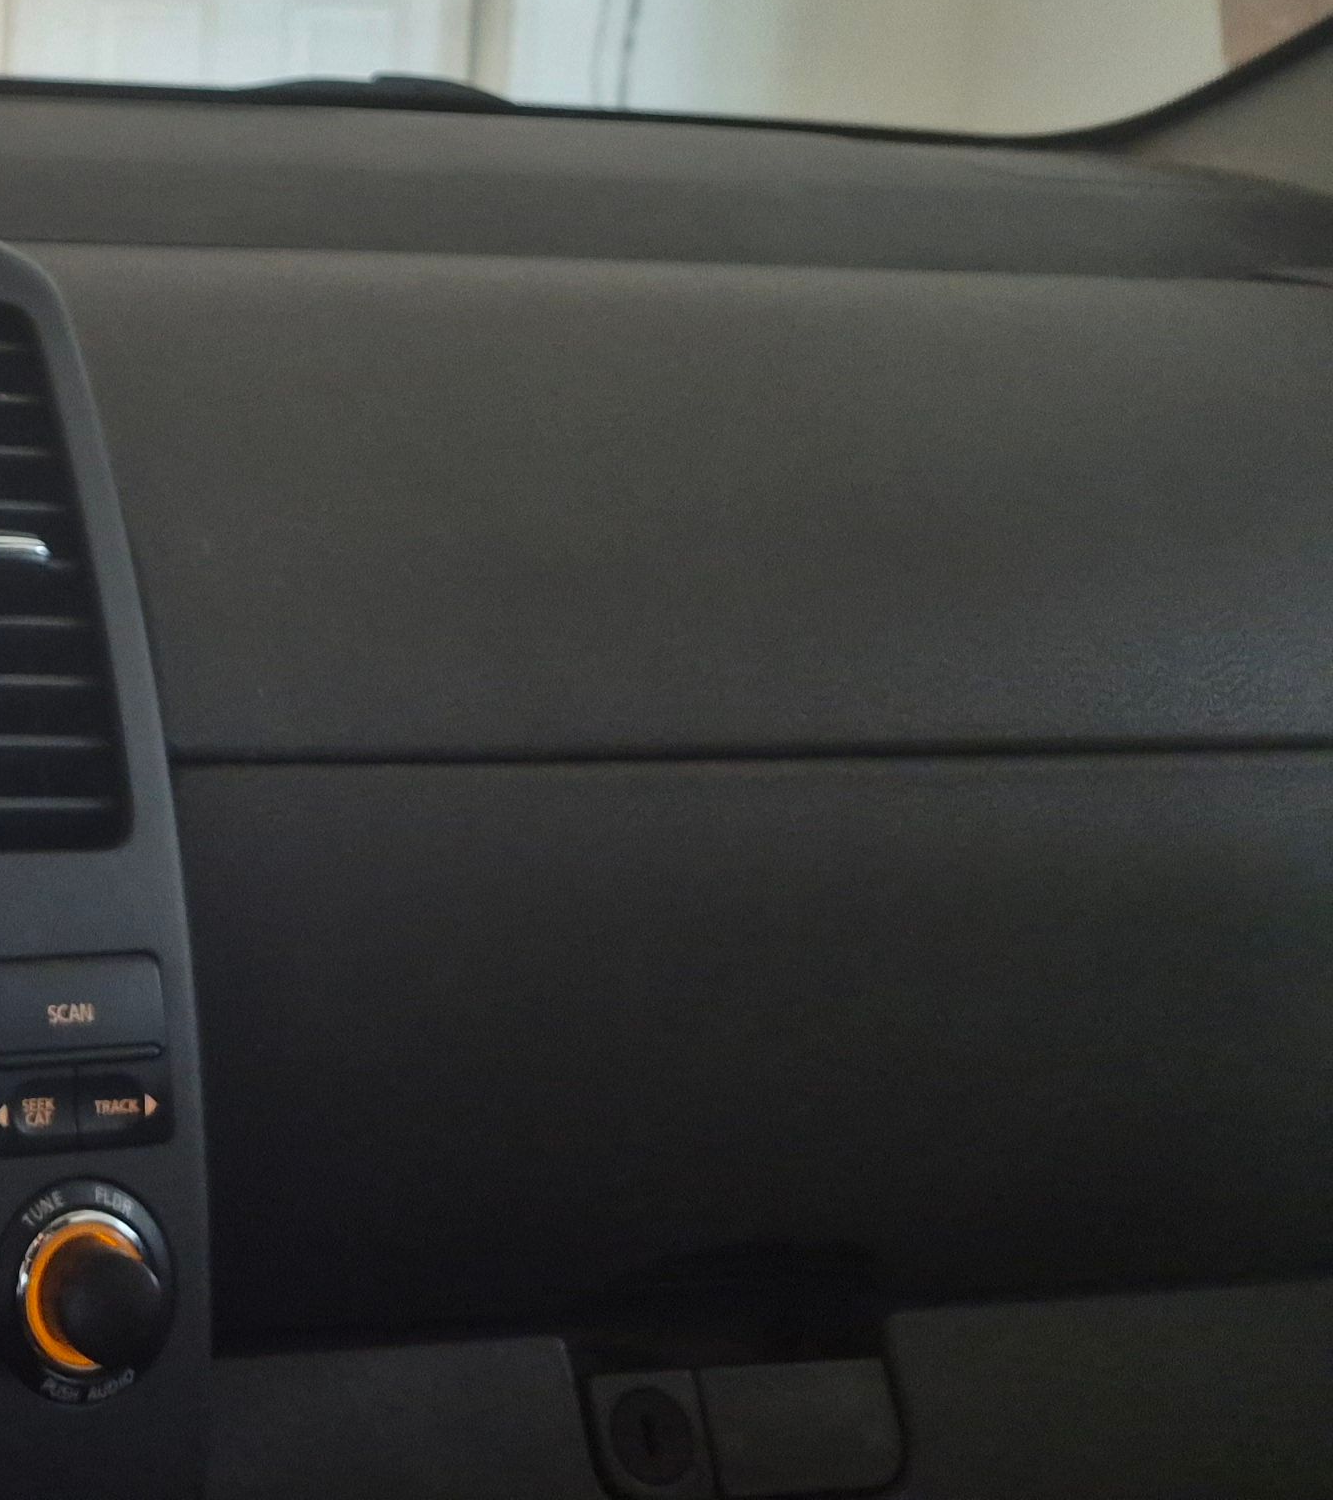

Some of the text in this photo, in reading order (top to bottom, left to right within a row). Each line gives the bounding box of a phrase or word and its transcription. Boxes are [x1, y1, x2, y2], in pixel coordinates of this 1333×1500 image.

[47, 1003, 95, 1025] SCAN
[22, 1097, 56, 1112] SEEK
[95, 1098, 141, 1116] TRACK
[25, 1111, 52, 1127] CAT
[21, 1190, 64, 1226] TUNE
